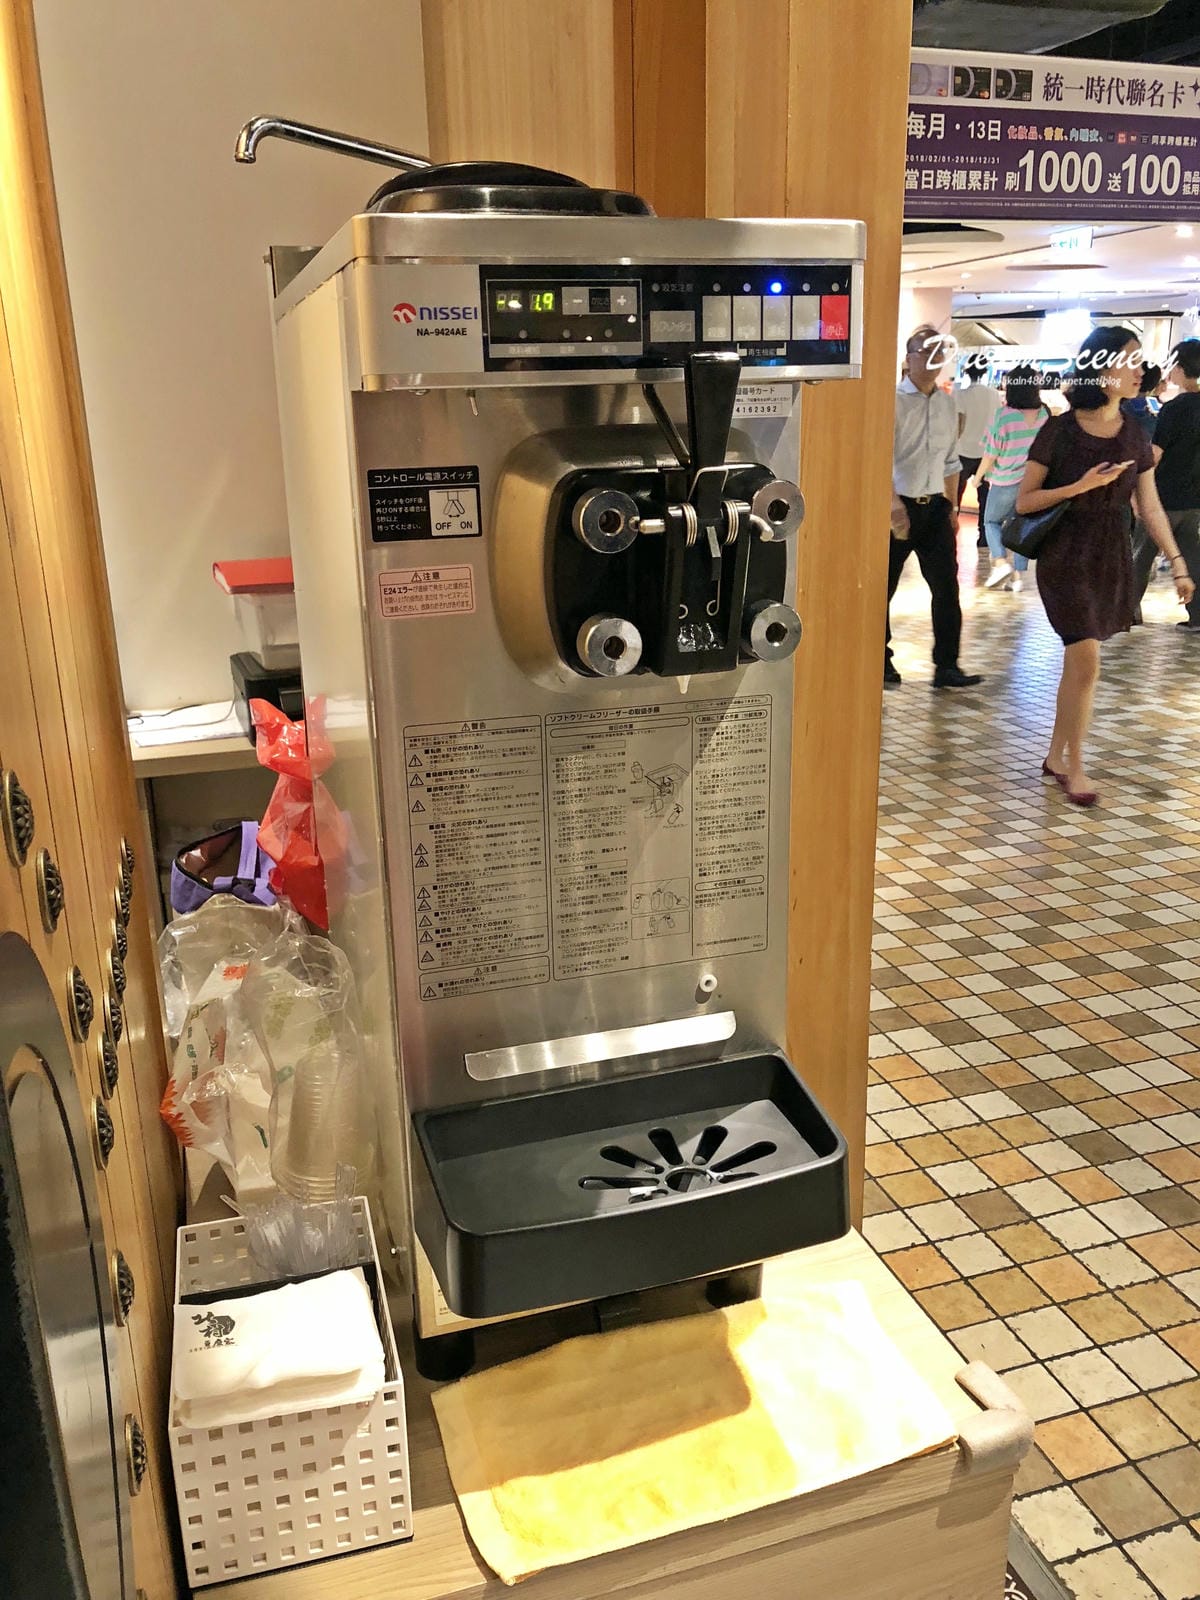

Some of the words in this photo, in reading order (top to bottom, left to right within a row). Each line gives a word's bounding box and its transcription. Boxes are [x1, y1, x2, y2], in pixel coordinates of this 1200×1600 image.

[1042, 71, 1186, 110] 統一時代聯名卡
[904, 168, 999, 192] 當日跨櫃累計
[419, 306, 479, 321] NISSEI
[416, 327, 468, 337] NA-9424AE
[374, 471, 474, 484] コントロール電源スイッチ
[435, 521, 452, 531] OFF
[460, 520, 473, 530] ON
[422, 571, 440, 581] 注意
